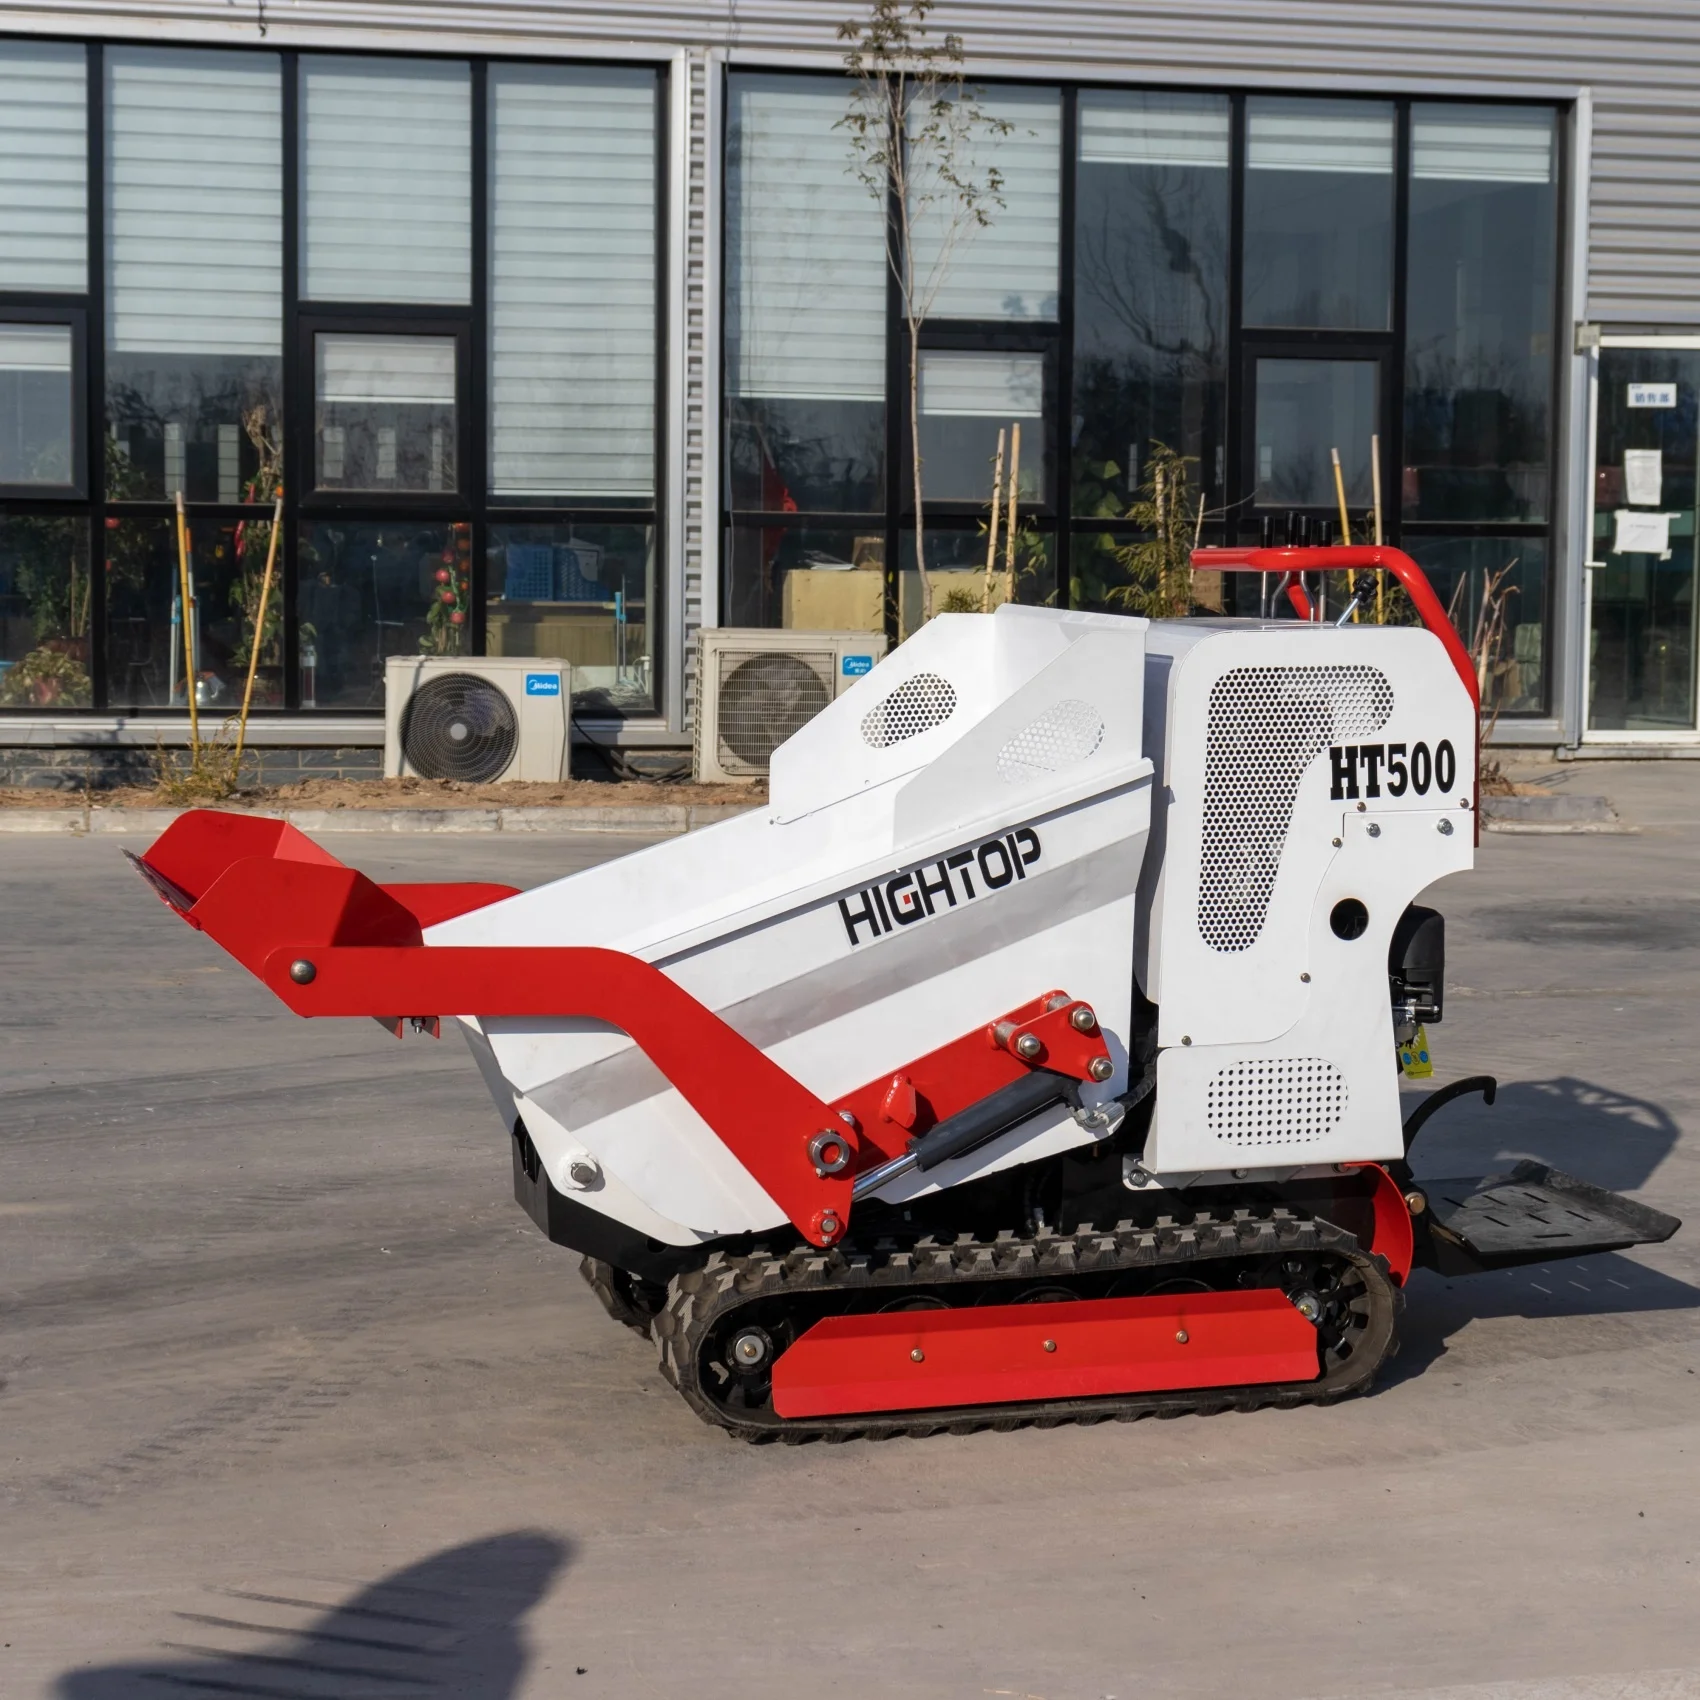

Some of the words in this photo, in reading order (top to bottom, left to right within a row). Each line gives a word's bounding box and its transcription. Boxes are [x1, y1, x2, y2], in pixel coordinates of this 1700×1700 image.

[531, 681, 558, 690] Midea
[1329, 739, 1456, 800] HT500
[838, 827, 1042, 946] HIGHTOP
